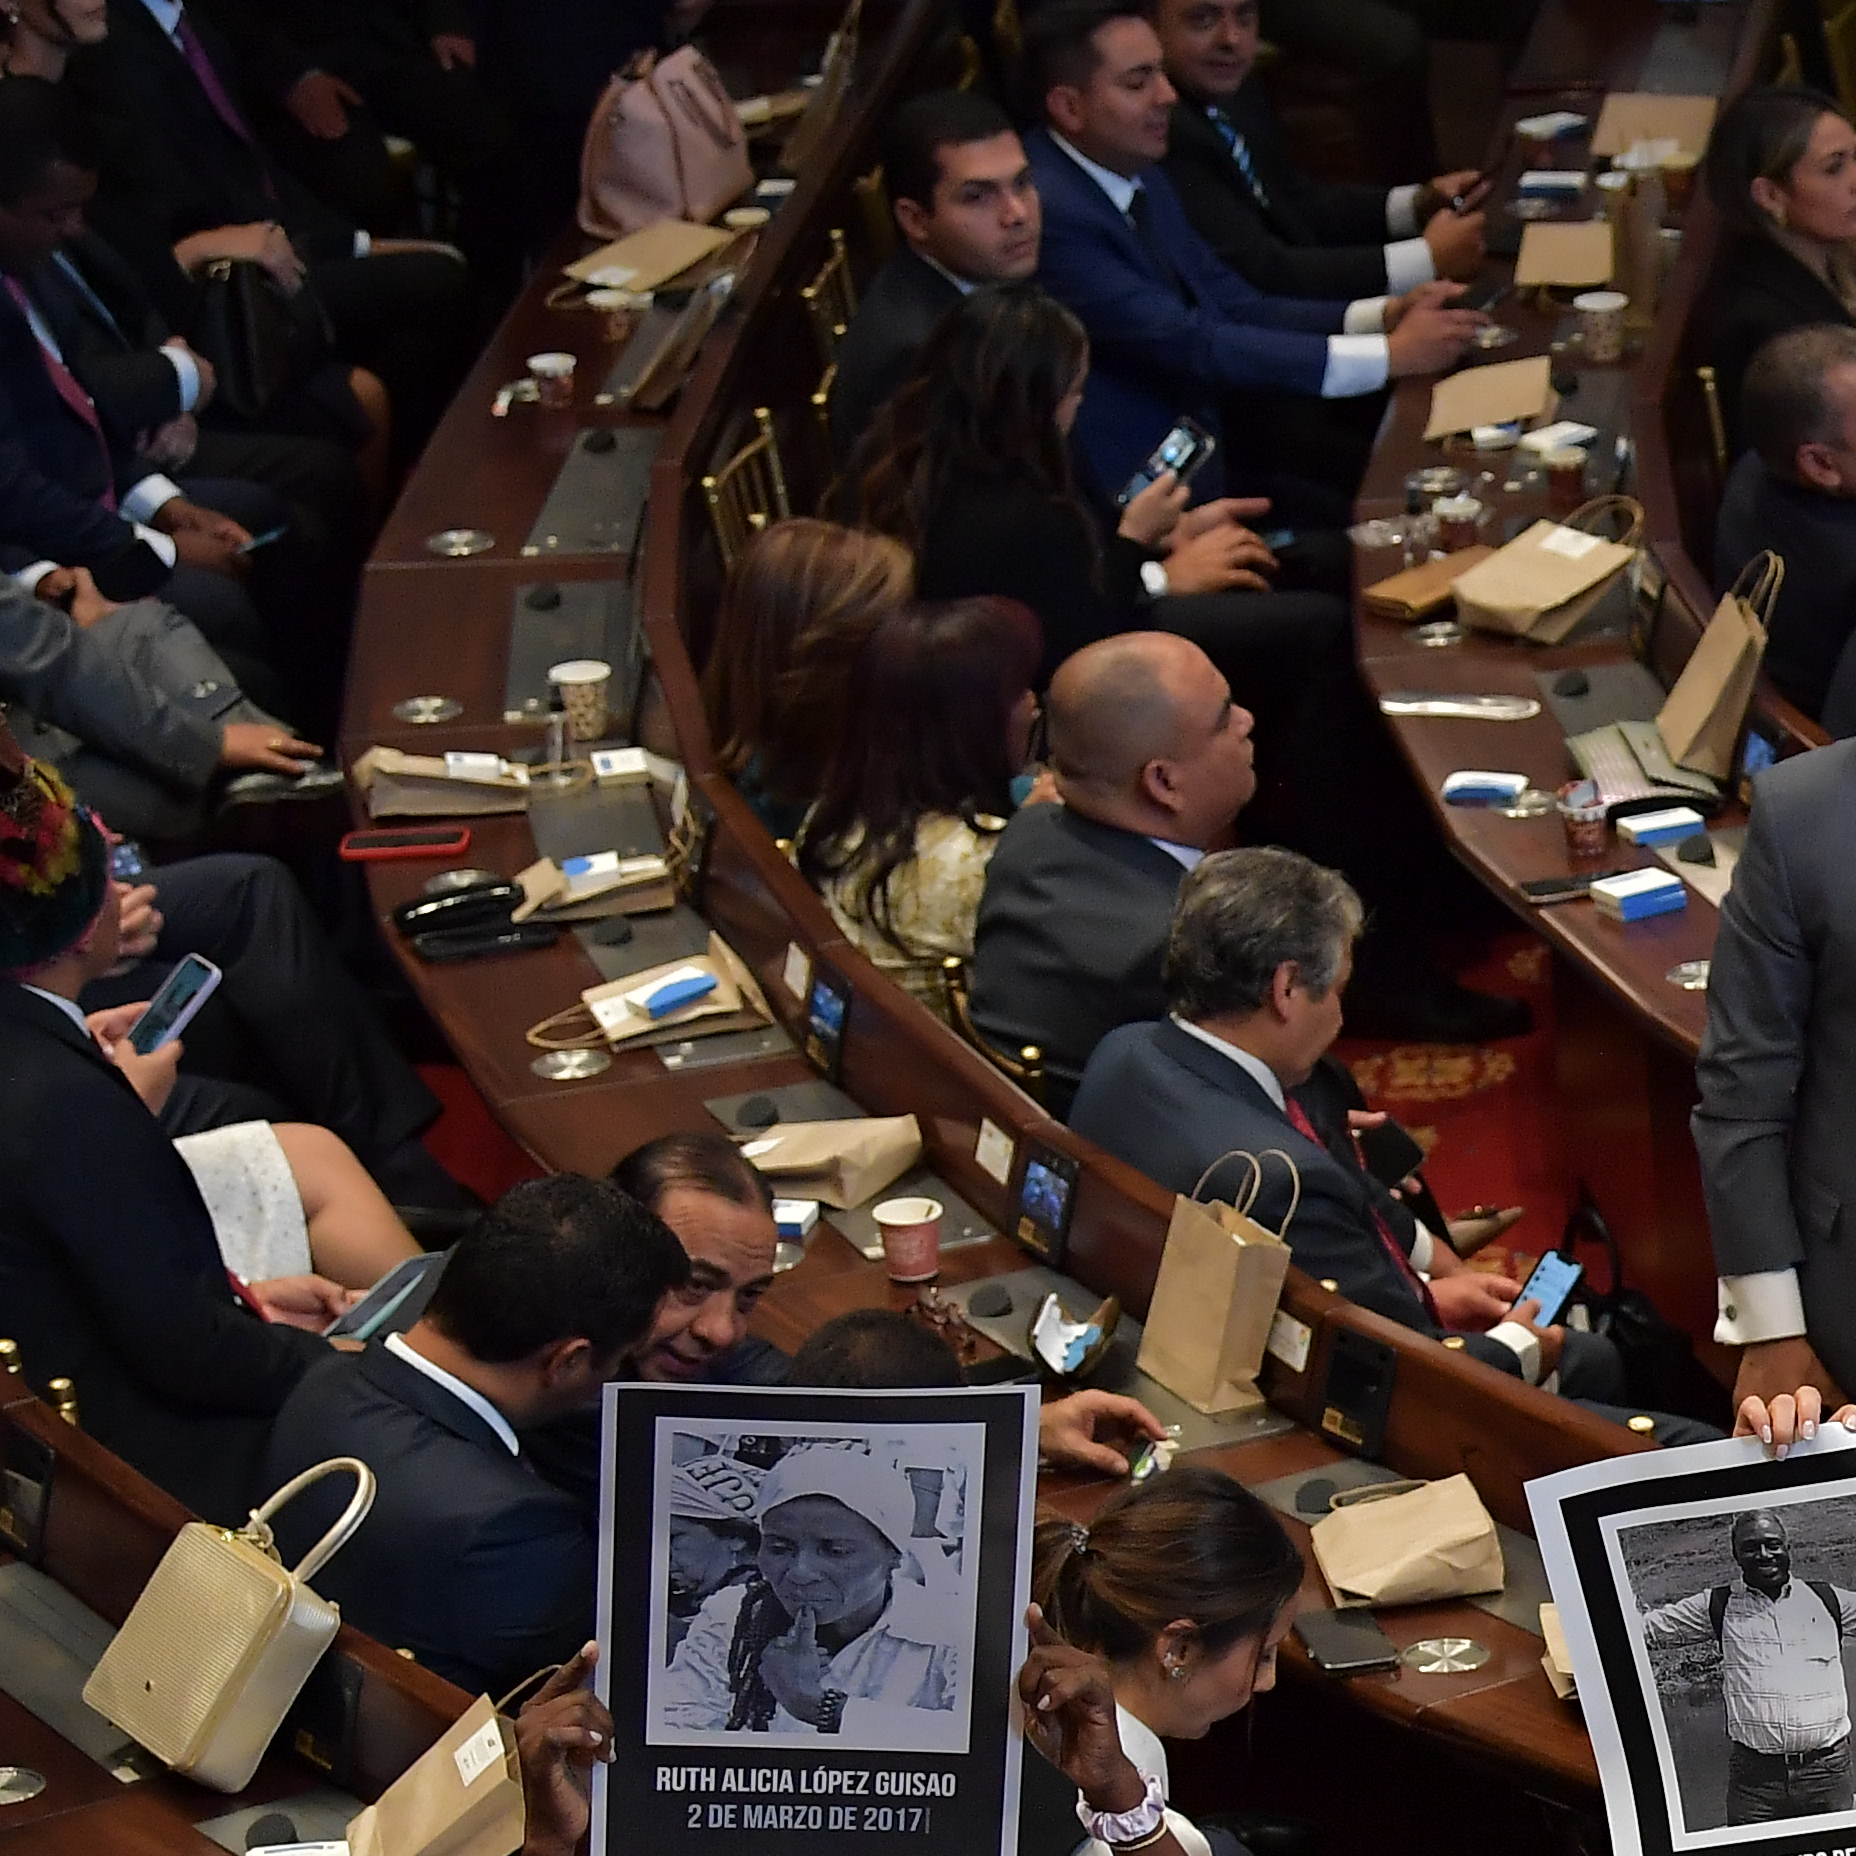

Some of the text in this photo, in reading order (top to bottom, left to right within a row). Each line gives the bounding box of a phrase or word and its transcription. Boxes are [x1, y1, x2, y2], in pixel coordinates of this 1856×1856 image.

[656, 1765, 956, 1797] RUTH ALICIA LÓPEZ GUISAO
[687, 1804, 923, 1832] 2 DE MARZO DE 2017
